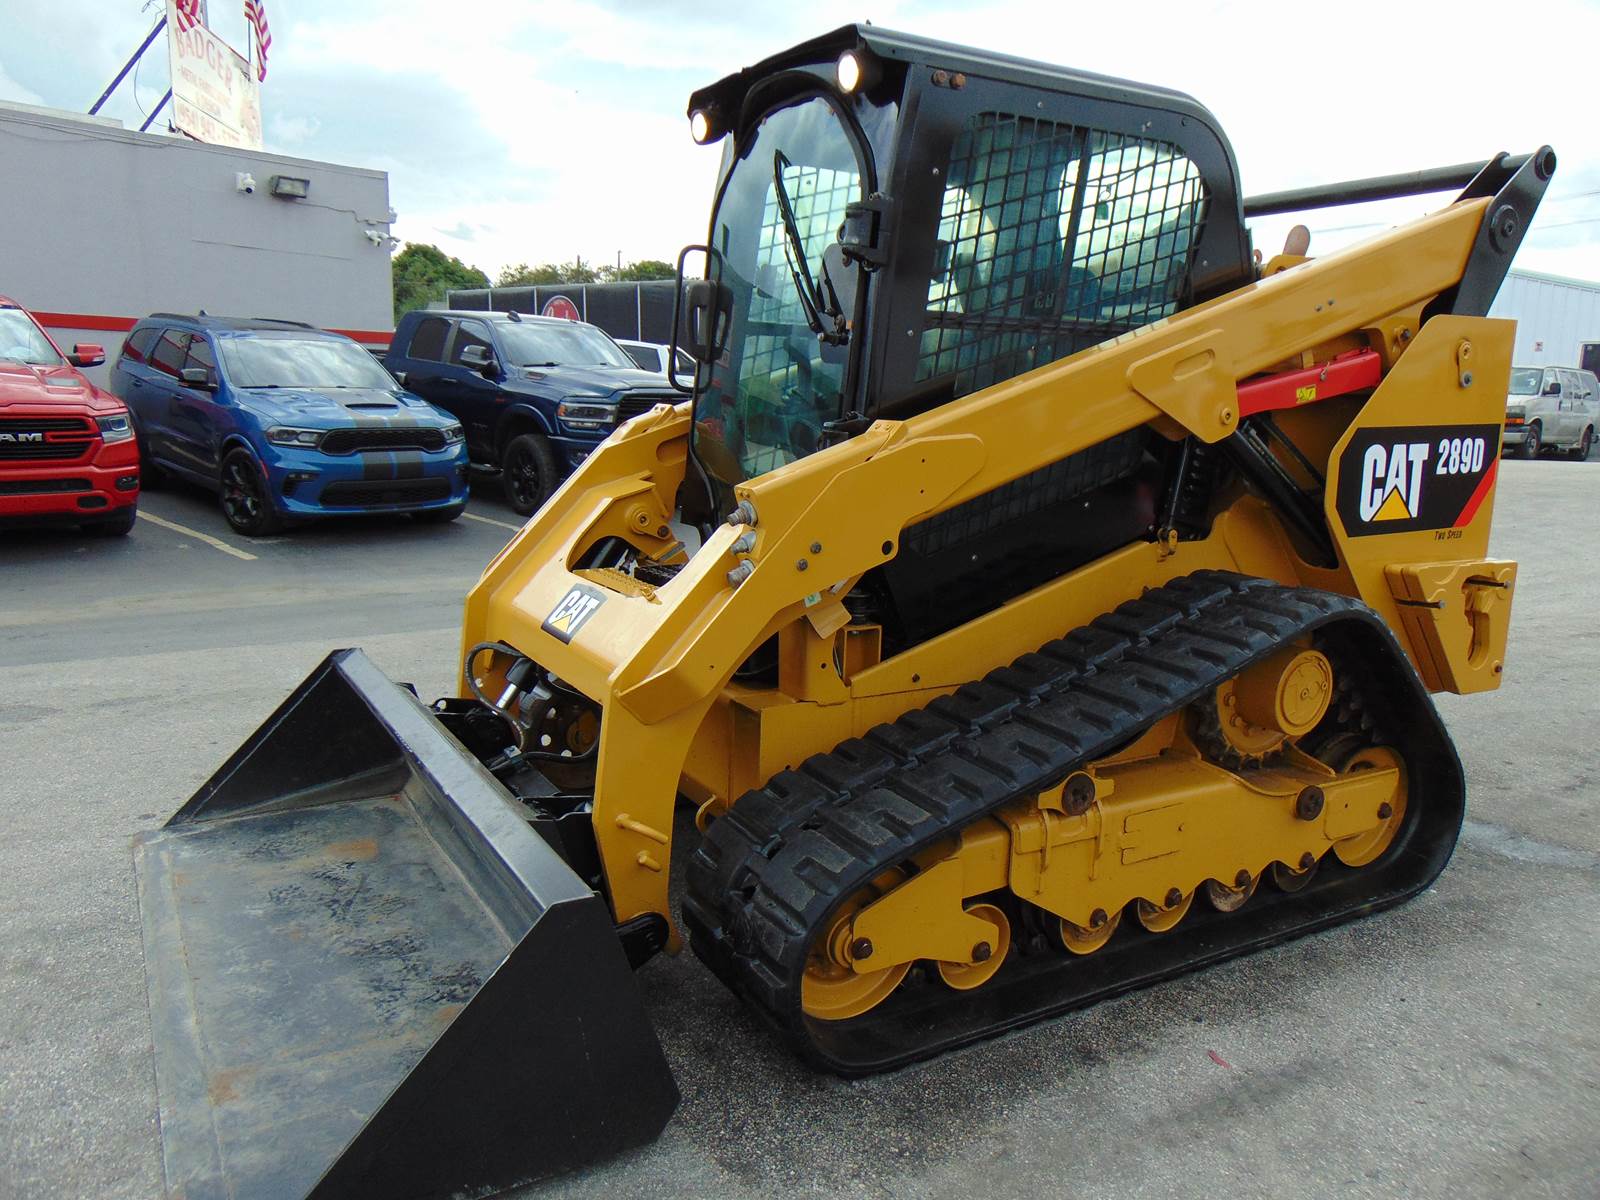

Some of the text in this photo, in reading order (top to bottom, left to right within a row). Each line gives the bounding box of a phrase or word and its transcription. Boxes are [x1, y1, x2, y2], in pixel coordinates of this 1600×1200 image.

[0, 432, 43, 442] AM
[1360, 437, 1485, 522] CAT 289D
[547, 590, 600, 635] CAT
